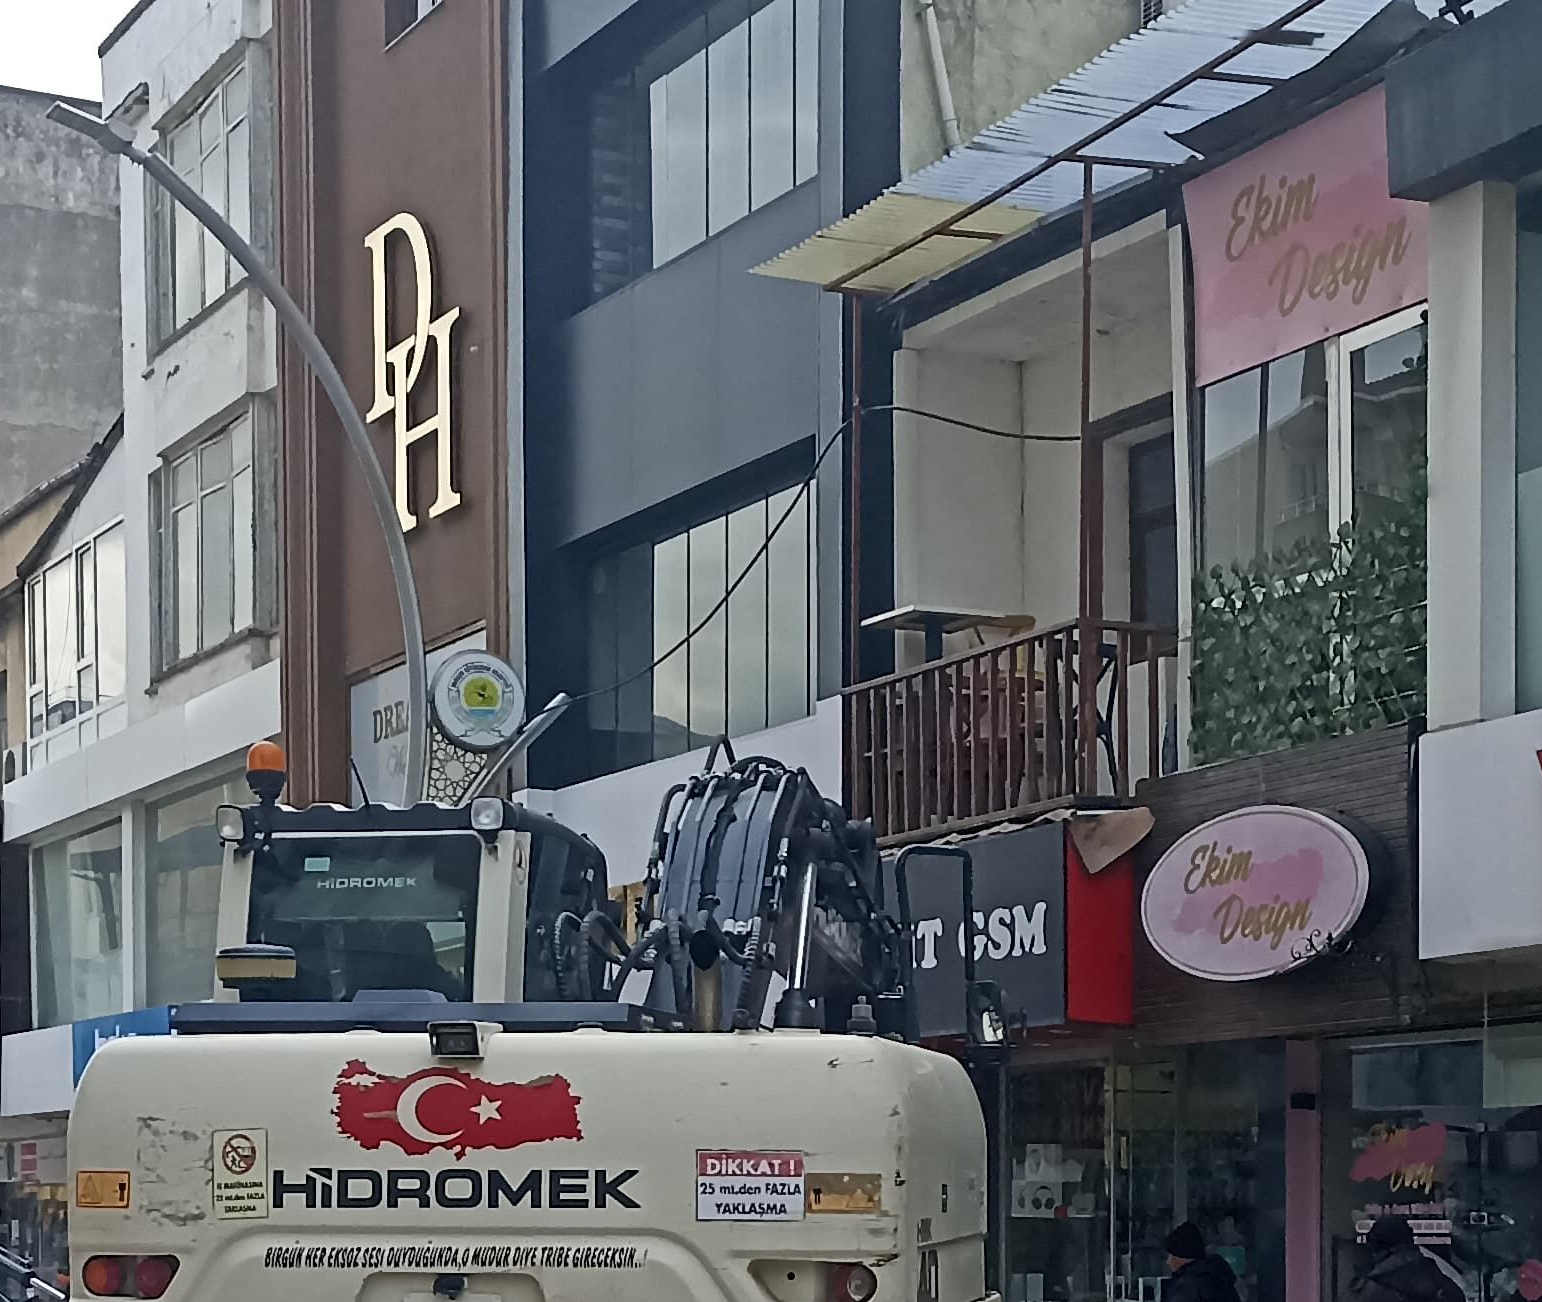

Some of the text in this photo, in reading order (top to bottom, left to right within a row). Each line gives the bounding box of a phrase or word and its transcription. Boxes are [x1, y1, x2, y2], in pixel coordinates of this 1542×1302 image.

[1226, 173, 1318, 262] Ekim
[1268, 216, 1411, 317] Design
[1184, 840, 1254, 894] Ekim
[958, 901, 1047, 961] GSM
[1213, 894, 1312, 950] Design
[273, 1166, 642, 1209] HİDROMEK
[706, 1154, 782, 1175] DİKKAT
[700, 1183, 716, 1195] 25
[765, 1183, 802, 1195] FAZLA
[715, 1203, 787, 1217] YAKLAŞMA
[305, 1246, 327, 1268] HER
